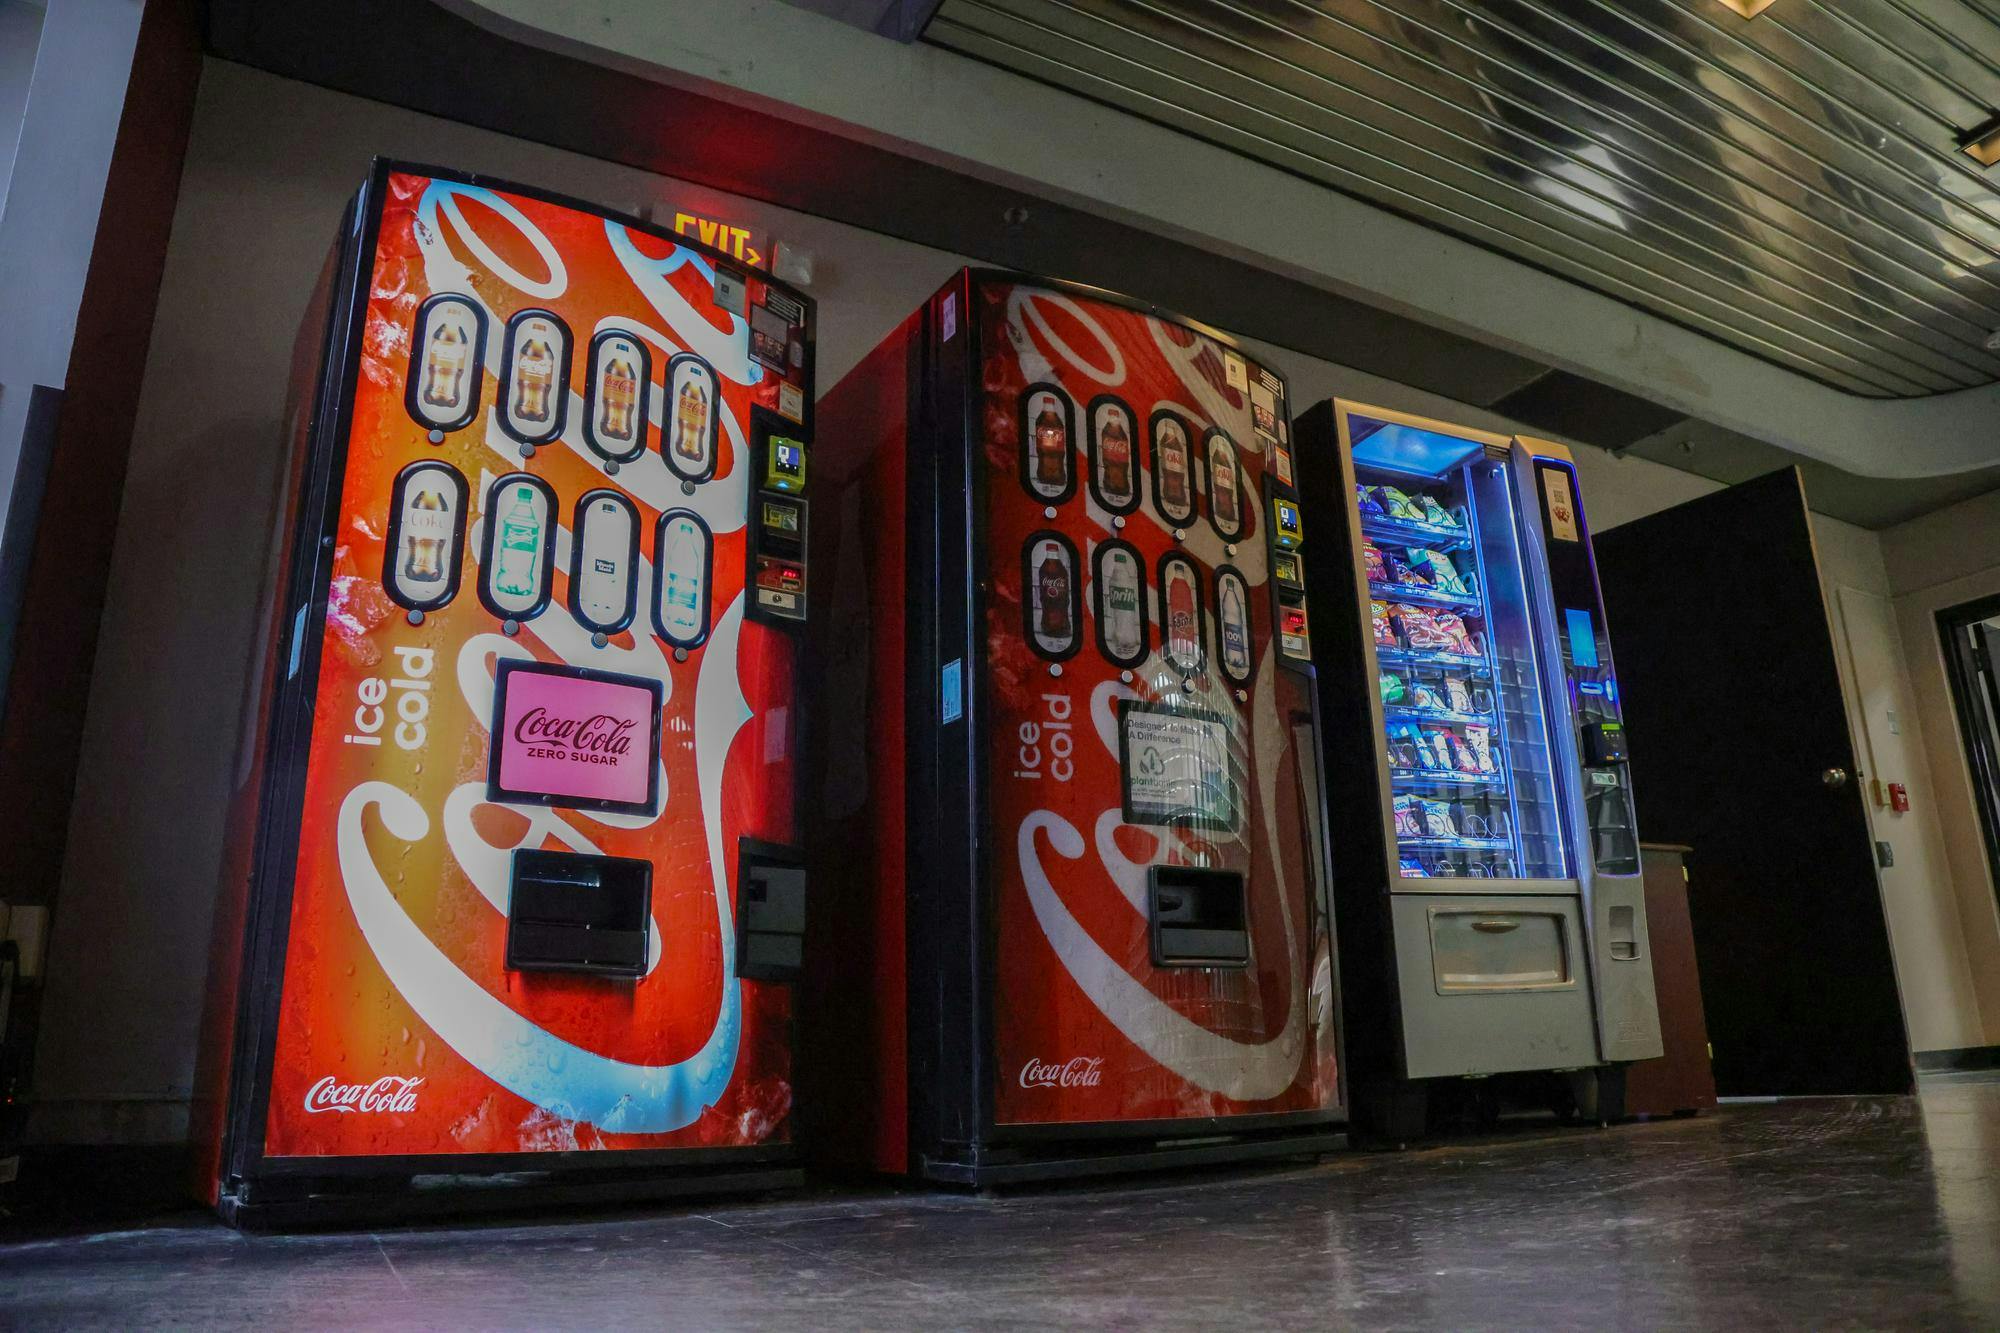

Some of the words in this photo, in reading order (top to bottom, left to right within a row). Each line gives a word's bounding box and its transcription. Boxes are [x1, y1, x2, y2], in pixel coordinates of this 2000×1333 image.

[344, 677, 388, 746] ice
[390, 645, 435, 751] cold
[514, 707, 638, 755] Coca-Cola
[1013, 721, 1042, 778] ice
[1041, 693, 1073, 782] cold
[1129, 731, 1136, 739] A
[1137, 732, 1181, 744] Difference
[527, 747, 566, 760] ZERO
[571, 752, 618, 767] SUGAR
[303, 1075, 426, 1113] Coca-Cola
[1019, 1056, 1105, 1089] Coca-Cola
